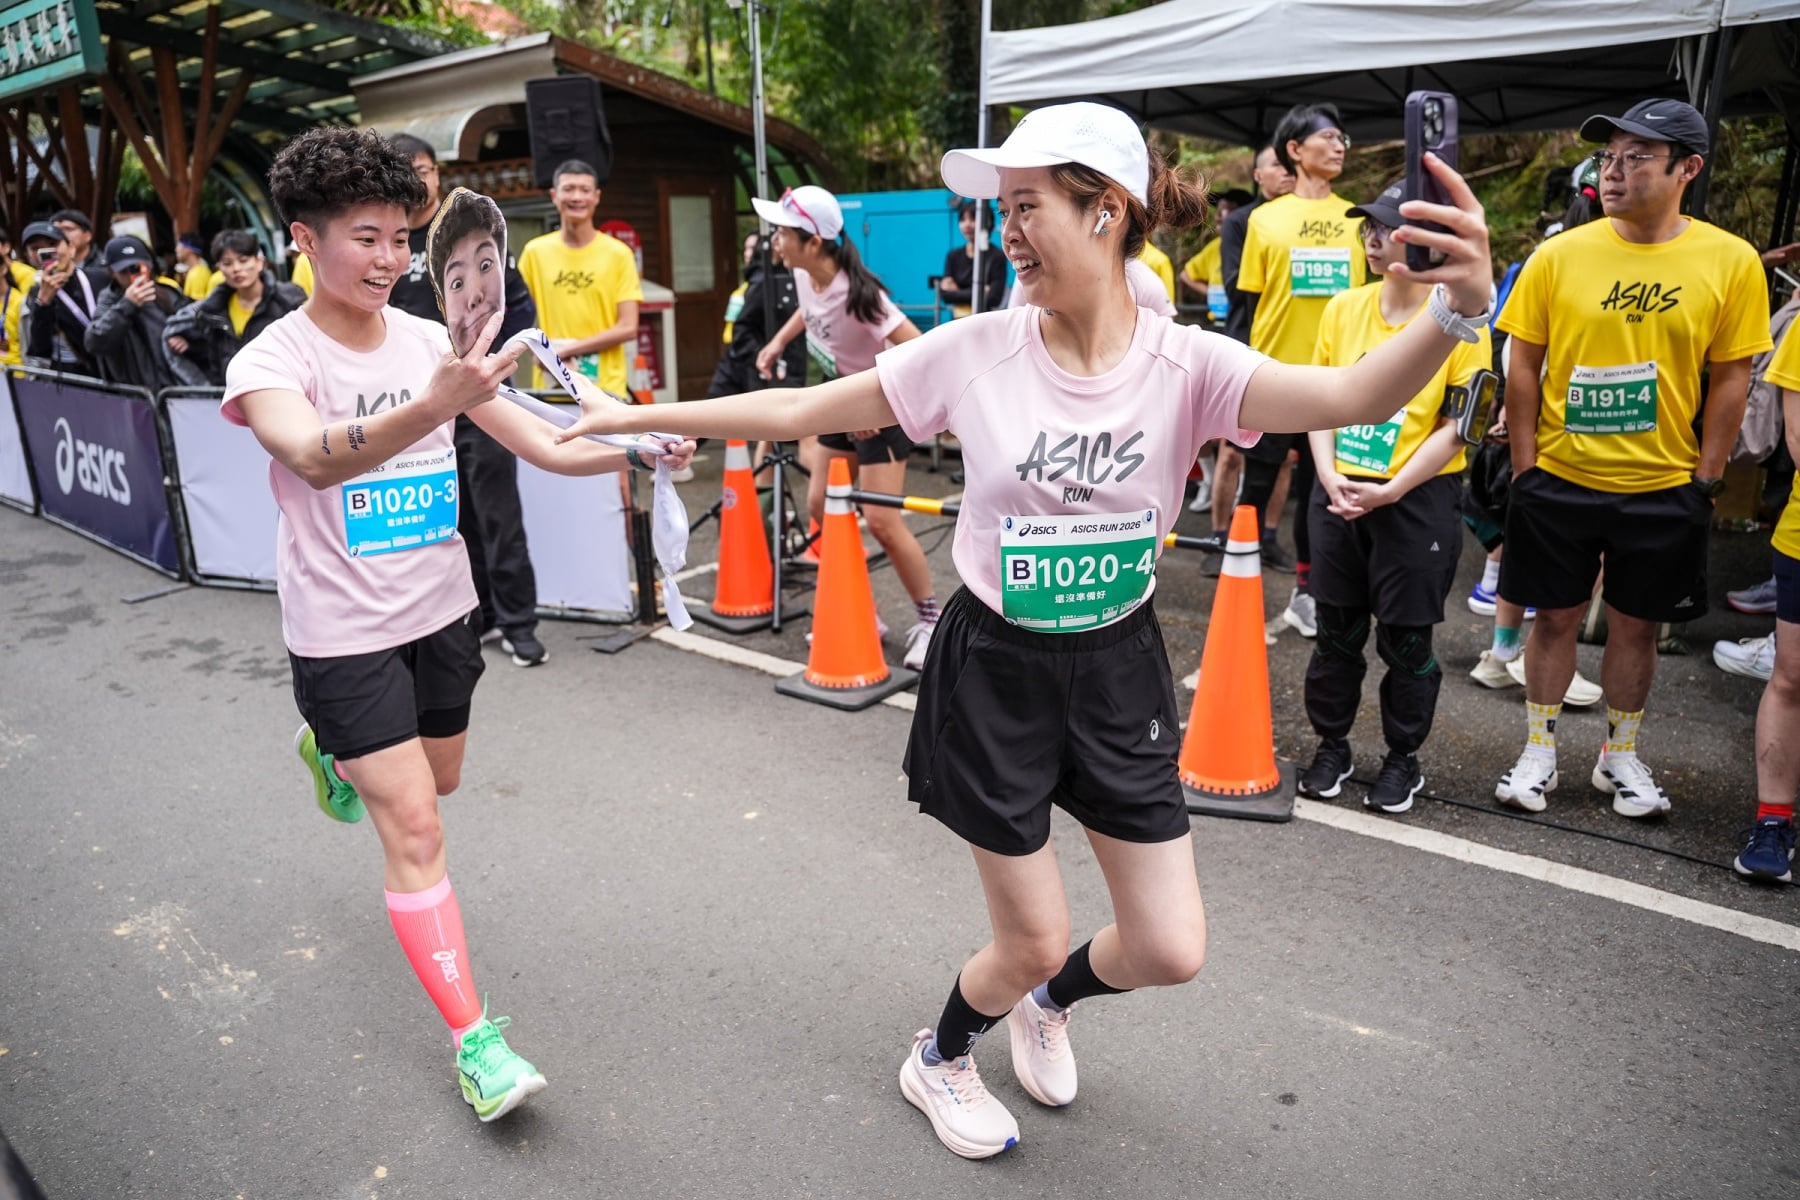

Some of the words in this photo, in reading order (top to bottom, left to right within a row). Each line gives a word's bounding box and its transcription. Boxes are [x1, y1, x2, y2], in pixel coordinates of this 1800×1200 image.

[1298, 220, 1344, 239] ASICS
[1306, 262, 1348, 278] 199-4
[1601, 280, 1682, 313] ASICS
[1626, 314, 1645, 324] RUN
[1571, 389, 1581, 402] B
[1588, 385, 1652, 408] 191-4
[348, 424, 361, 451] ASICS
[355, 425, 367, 444] RUN
[1016, 430, 1145, 484] ASICS
[352, 493, 366, 509] B
[371, 479, 456, 514] 1020-3
[1062, 486, 1094, 504] RUN
[1071, 524, 1098, 534] ASICS
[1099, 523, 1118, 532] RUN
[1119, 520, 1141, 531] 2026
[1012, 559, 1031, 580] B
[1038, 548, 1153, 588] 1020-4
